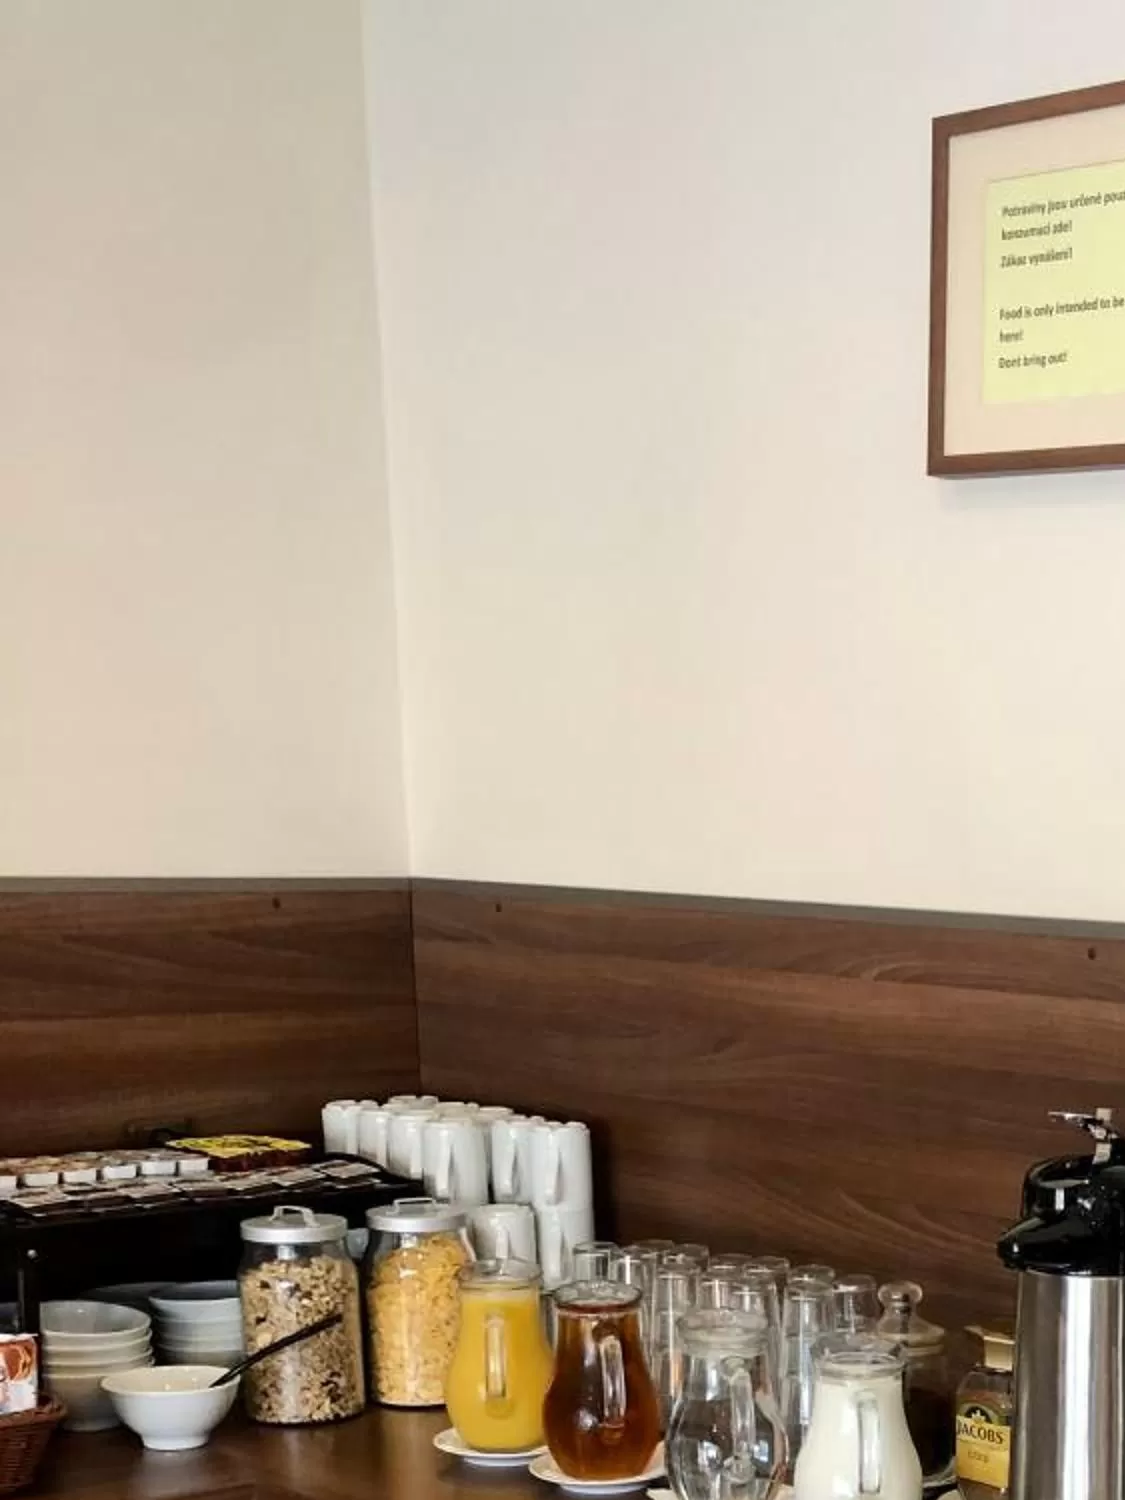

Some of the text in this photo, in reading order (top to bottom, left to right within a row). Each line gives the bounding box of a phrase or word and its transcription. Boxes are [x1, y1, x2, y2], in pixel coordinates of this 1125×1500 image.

[999, 306, 1022, 320] Food
[1033, 304, 1054, 317] only
[1055, 298, 1098, 314] intended
[1100, 298, 1110, 309] to
[1112, 296, 1124, 308] be
[999, 329, 1023, 342] here!
[1023, 354, 1046, 368] bring
[1048, 351, 1067, 365] out!
[957, 1420, 1004, 1444] JACOBS
